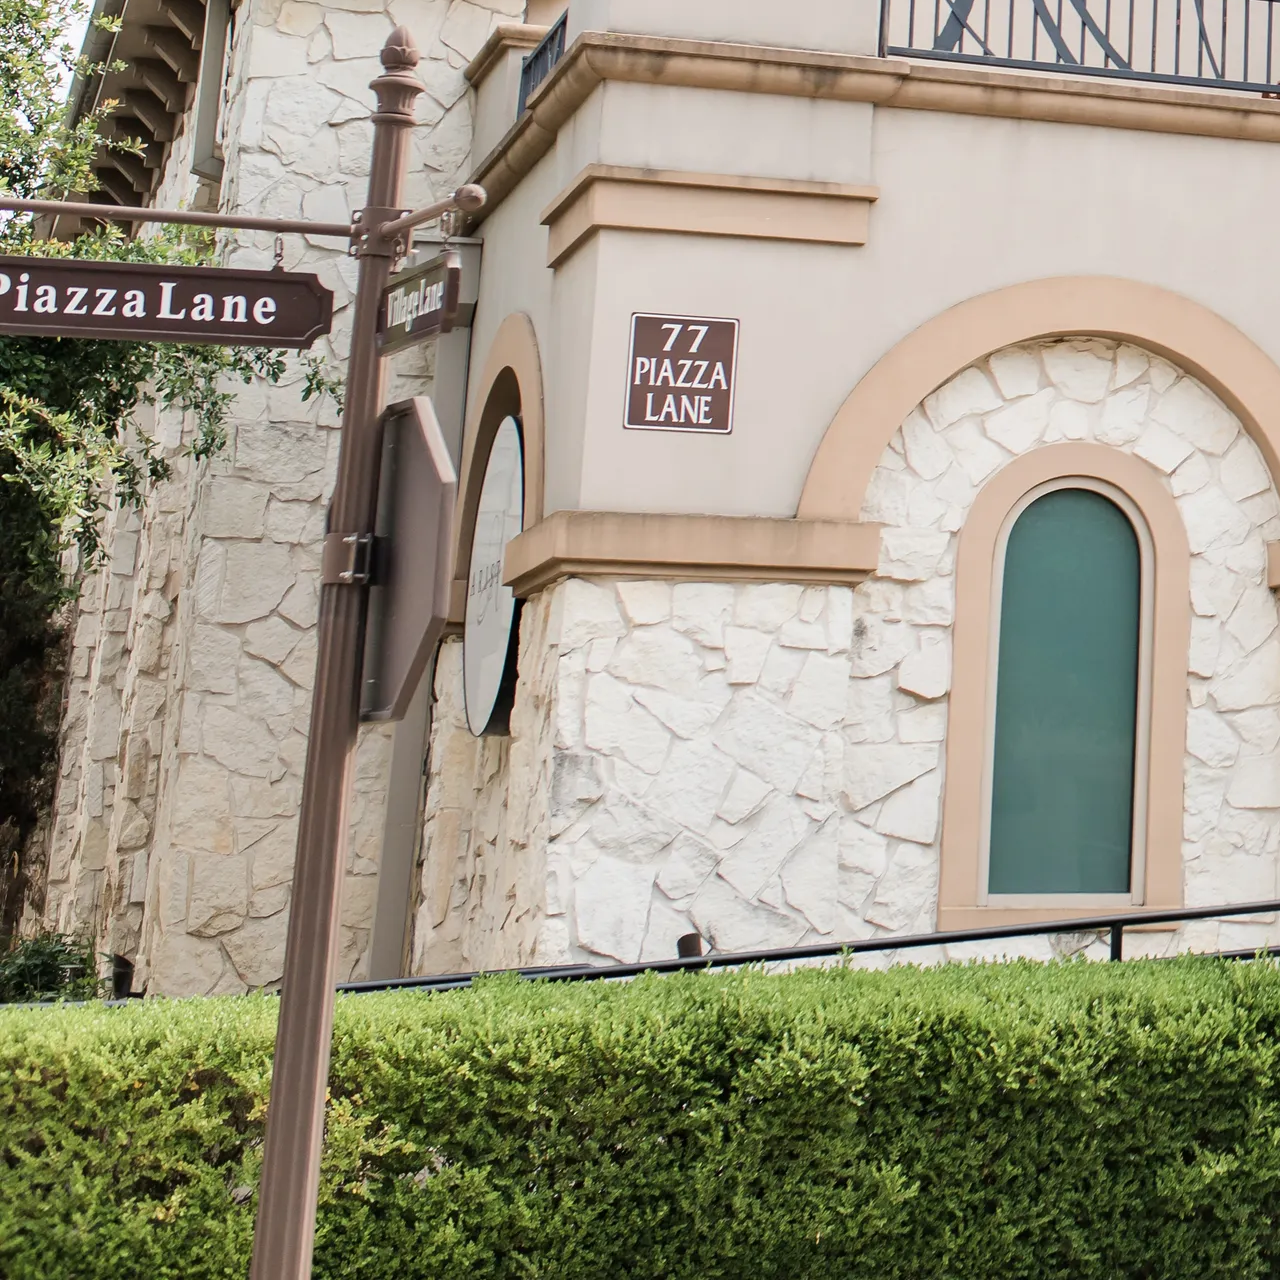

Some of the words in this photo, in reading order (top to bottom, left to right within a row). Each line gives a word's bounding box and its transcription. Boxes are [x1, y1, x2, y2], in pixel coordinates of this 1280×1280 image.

[156, 281, 278, 325] Lane
[417, 278, 445, 317] Lane
[661, 323, 709, 353] 77
[633, 356, 728, 390] PIAZZA
[644, 392, 712, 424] LANE
